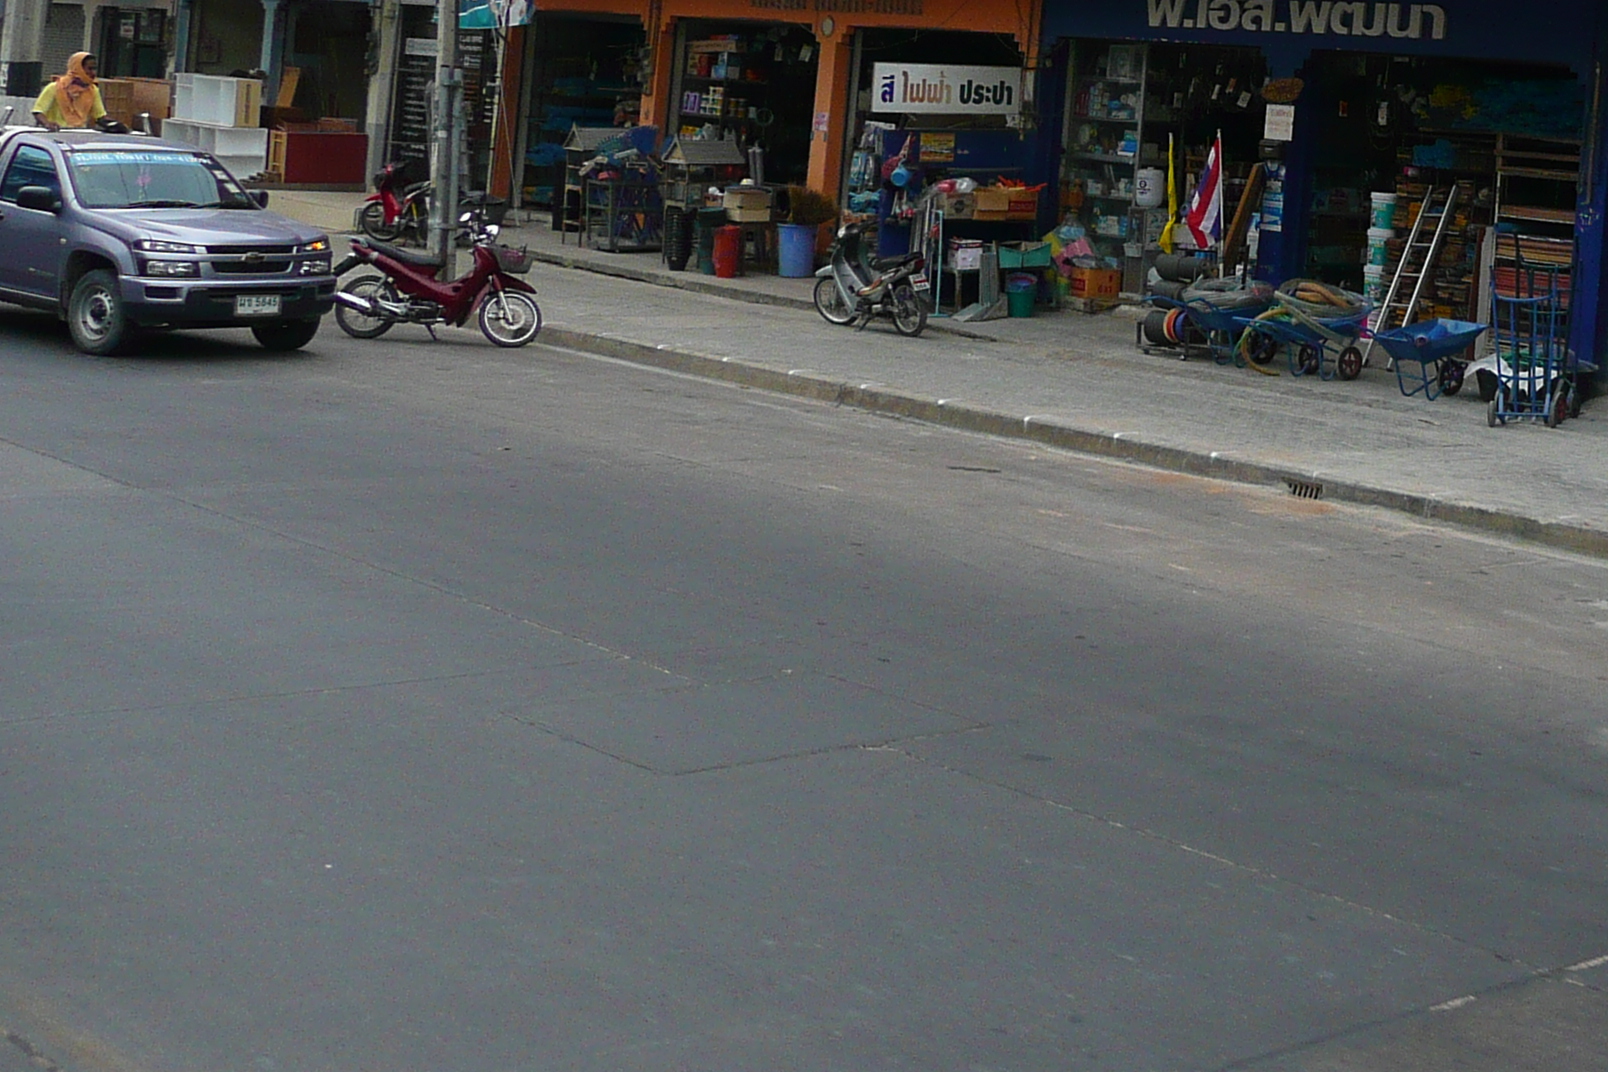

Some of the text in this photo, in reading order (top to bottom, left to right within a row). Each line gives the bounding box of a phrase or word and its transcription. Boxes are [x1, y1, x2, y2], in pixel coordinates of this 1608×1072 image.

[881, 70, 1012, 106] สี ไฟฟ้า ประปา
